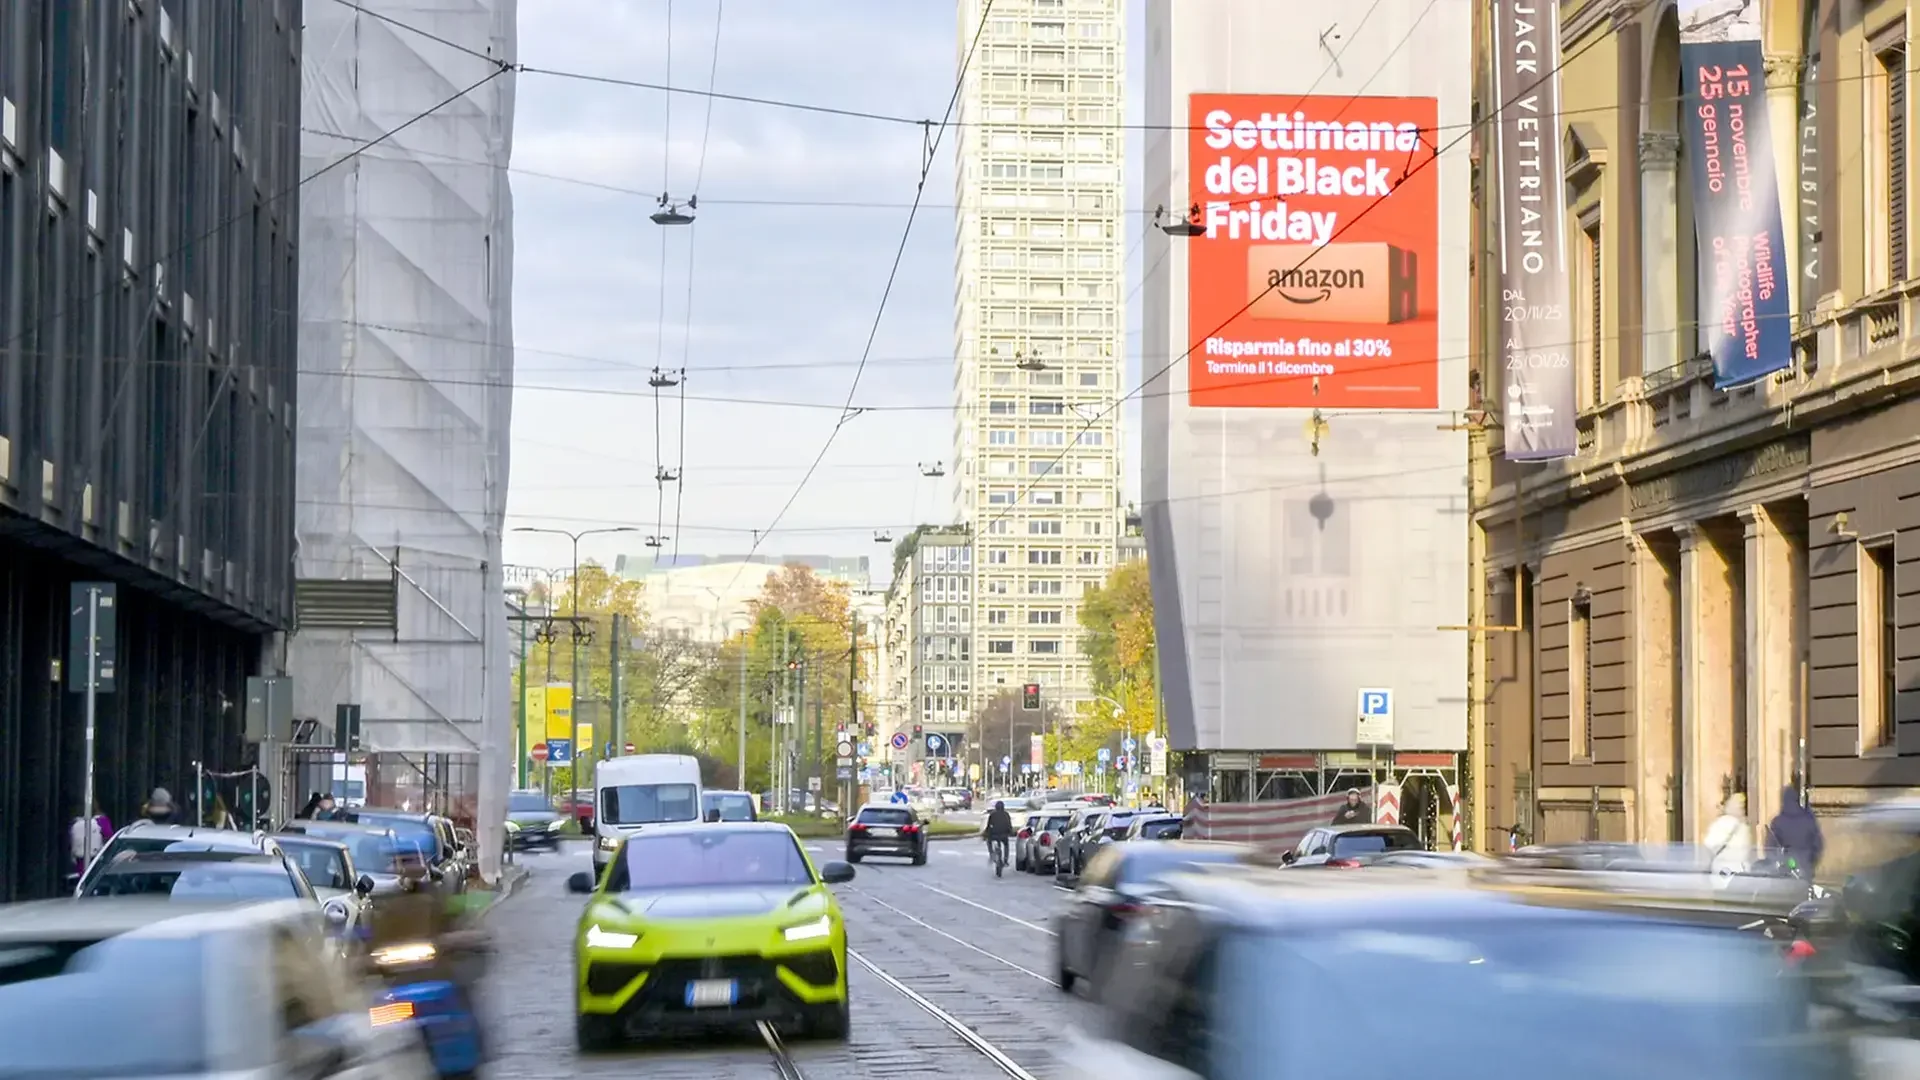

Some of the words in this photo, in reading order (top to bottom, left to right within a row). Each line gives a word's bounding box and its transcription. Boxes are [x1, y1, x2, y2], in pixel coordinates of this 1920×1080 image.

[1514, 2, 1537, 74] JACK
[1698, 65, 1723, 100] 25
[1726, 63, 1750, 97] 15
[1204, 110, 1420, 151] Settimana
[1698, 104, 1726, 193] gennaio
[1729, 104, 1753, 211] novembre
[1204, 156, 1268, 194] del
[1277, 157, 1392, 196] Black
[1517, 95, 1544, 274] VETTRIANO
[1206, 200, 1337, 246] Friday
[1267, 268, 1364, 289] amazon
[1753, 231, 1776, 301] Wildlife
[1503, 289, 1526, 301] DAL
[1503, 305, 1563, 322] 20/11/25
[1206, 337, 1296, 358] Risparmia
[1297, 338, 1333, 356] fino
[1334, 338, 1351, 356] al
[1353, 338, 1392, 357] 30%
[1505, 337, 1521, 349] AL
[1206, 360, 1257, 374] Termina
[1258, 361, 1265, 374] il
[1267, 361, 1273, 374] 1
[1275, 361, 1335, 375] dicembre
[1506, 353, 1570, 370] 25/01/26
[1367, 693, 1384, 715] P
